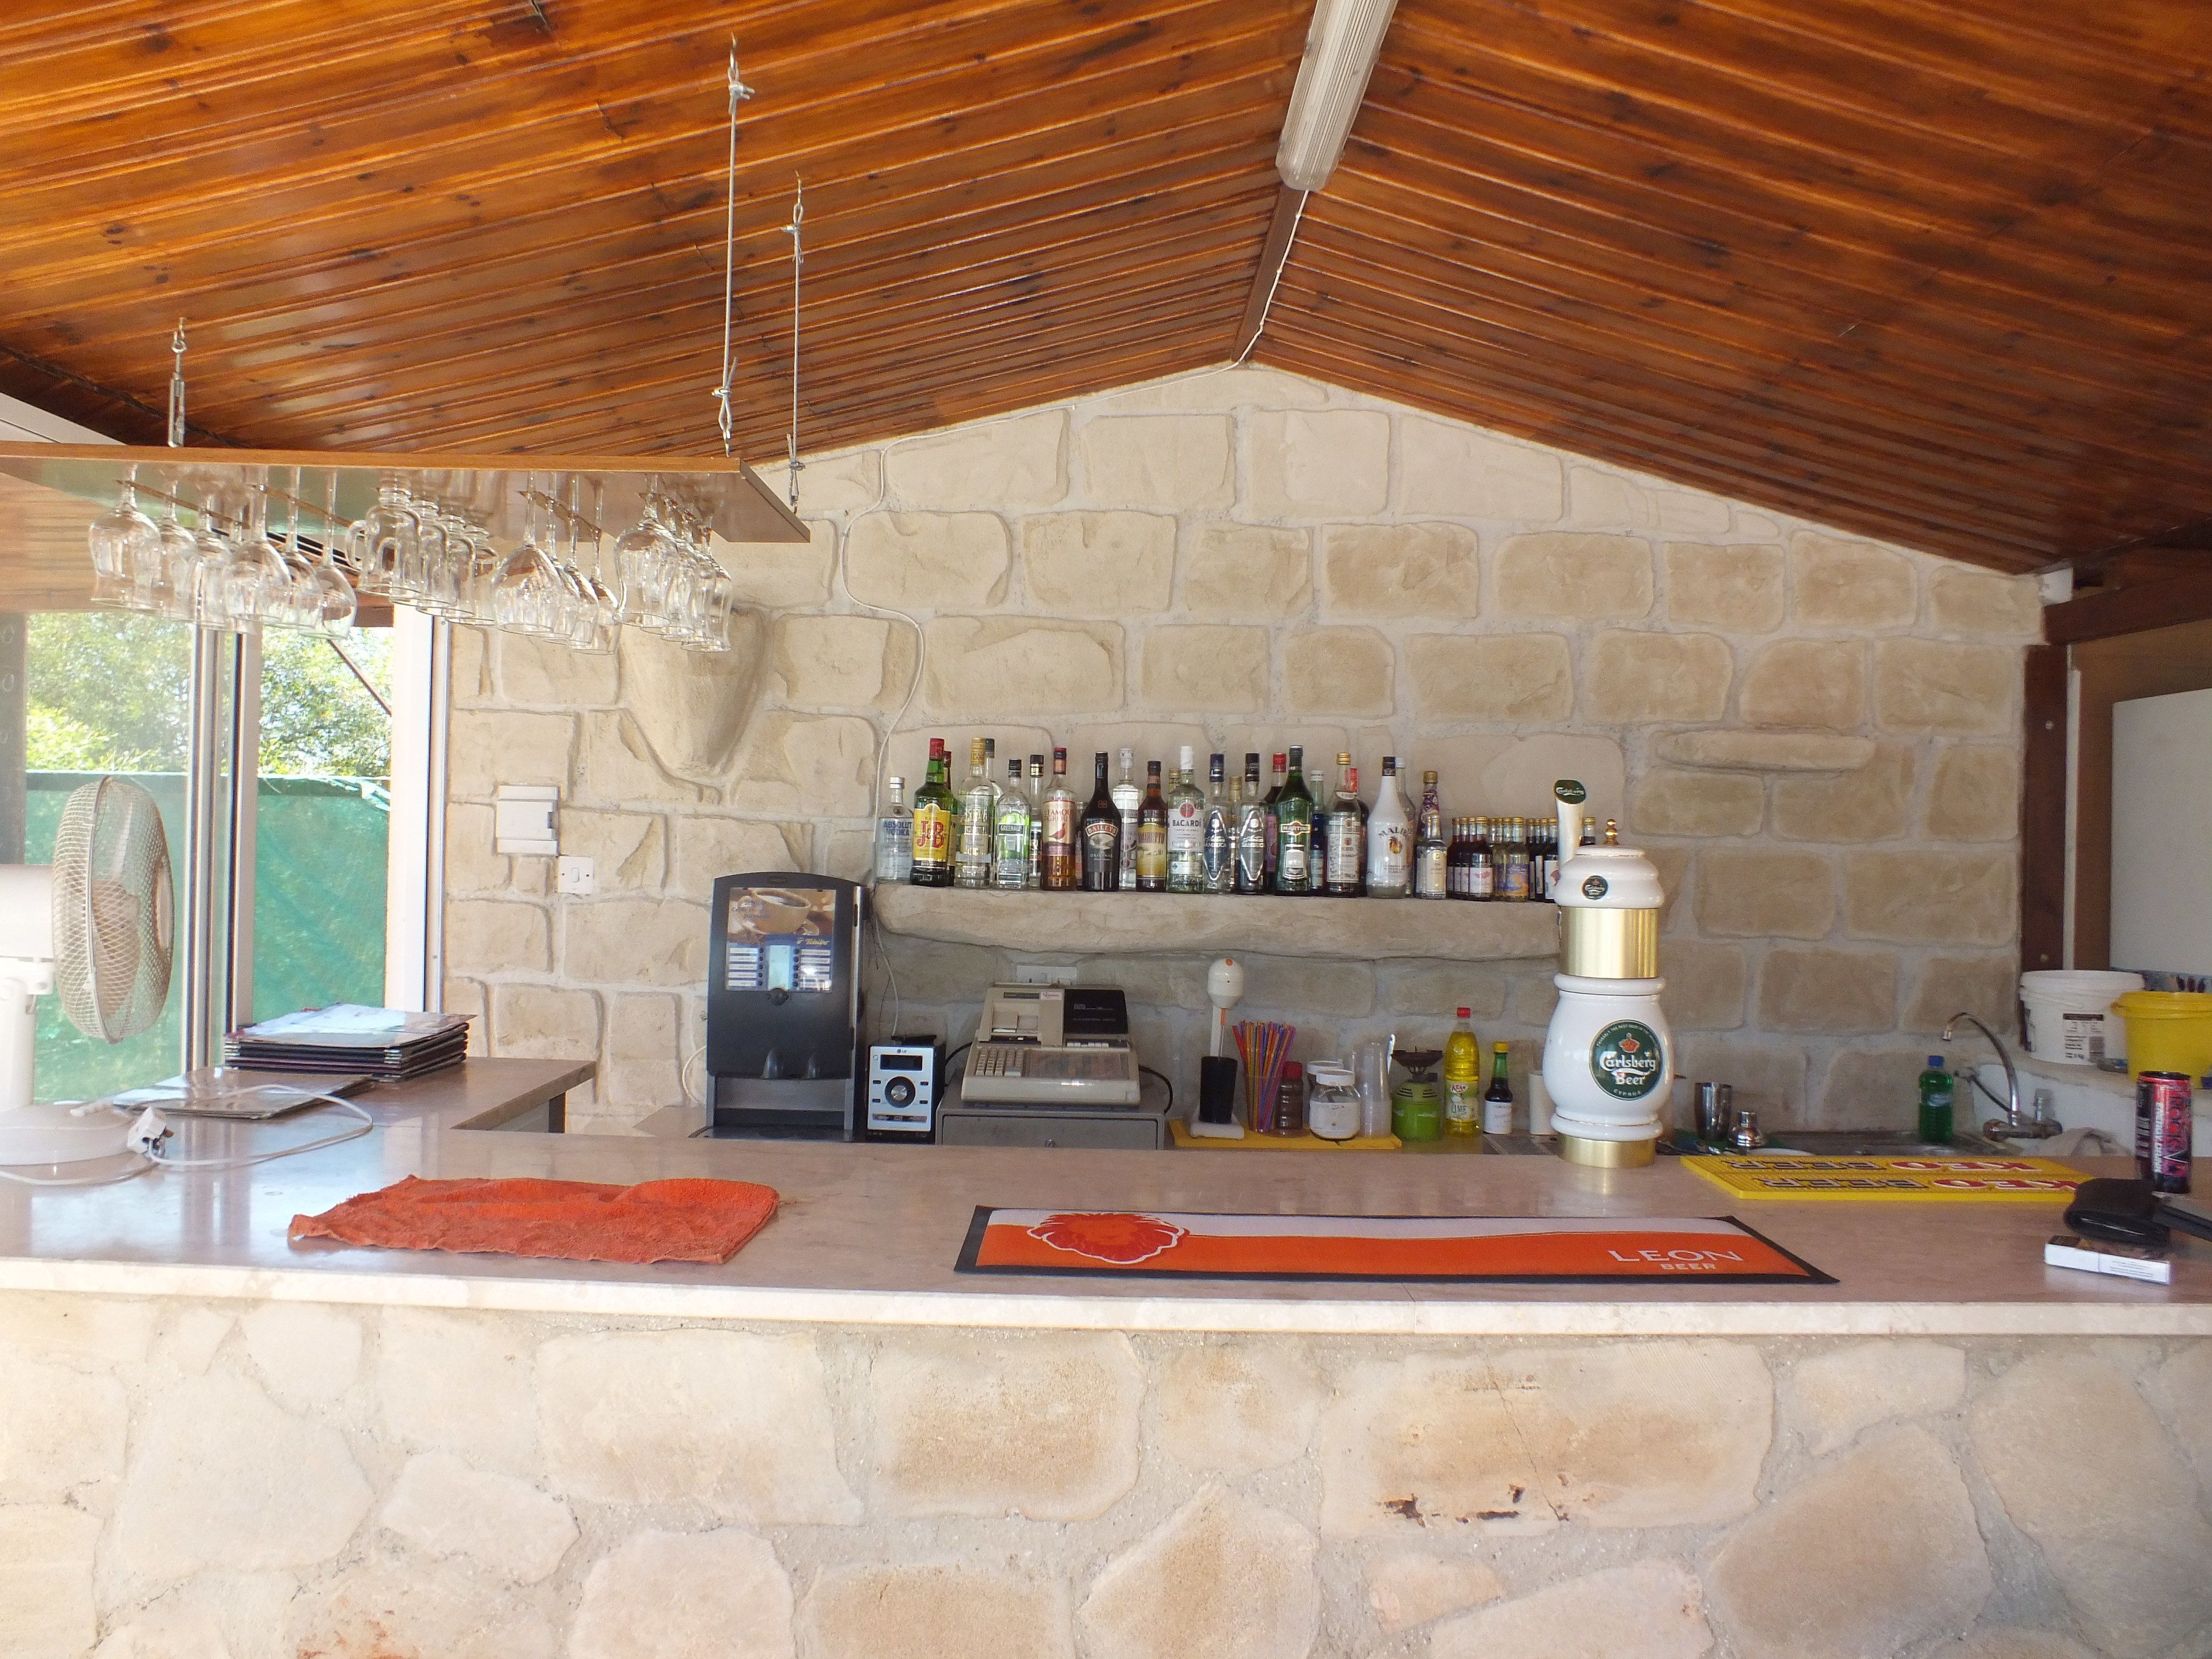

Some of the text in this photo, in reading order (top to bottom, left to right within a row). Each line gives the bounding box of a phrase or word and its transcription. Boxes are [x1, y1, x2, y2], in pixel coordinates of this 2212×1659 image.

[1088, 824, 1116, 834] BAILEYS
[1599, 1050, 1656, 1072] Carlsberg
[1615, 1071, 1646, 1085] Beer
[1721, 1160, 2043, 1172] KEO BEER
[1753, 1177, 1929, 1188] BEER
[1607, 1249, 1744, 1262] LEON
[1660, 1262, 1717, 1270] BEER
